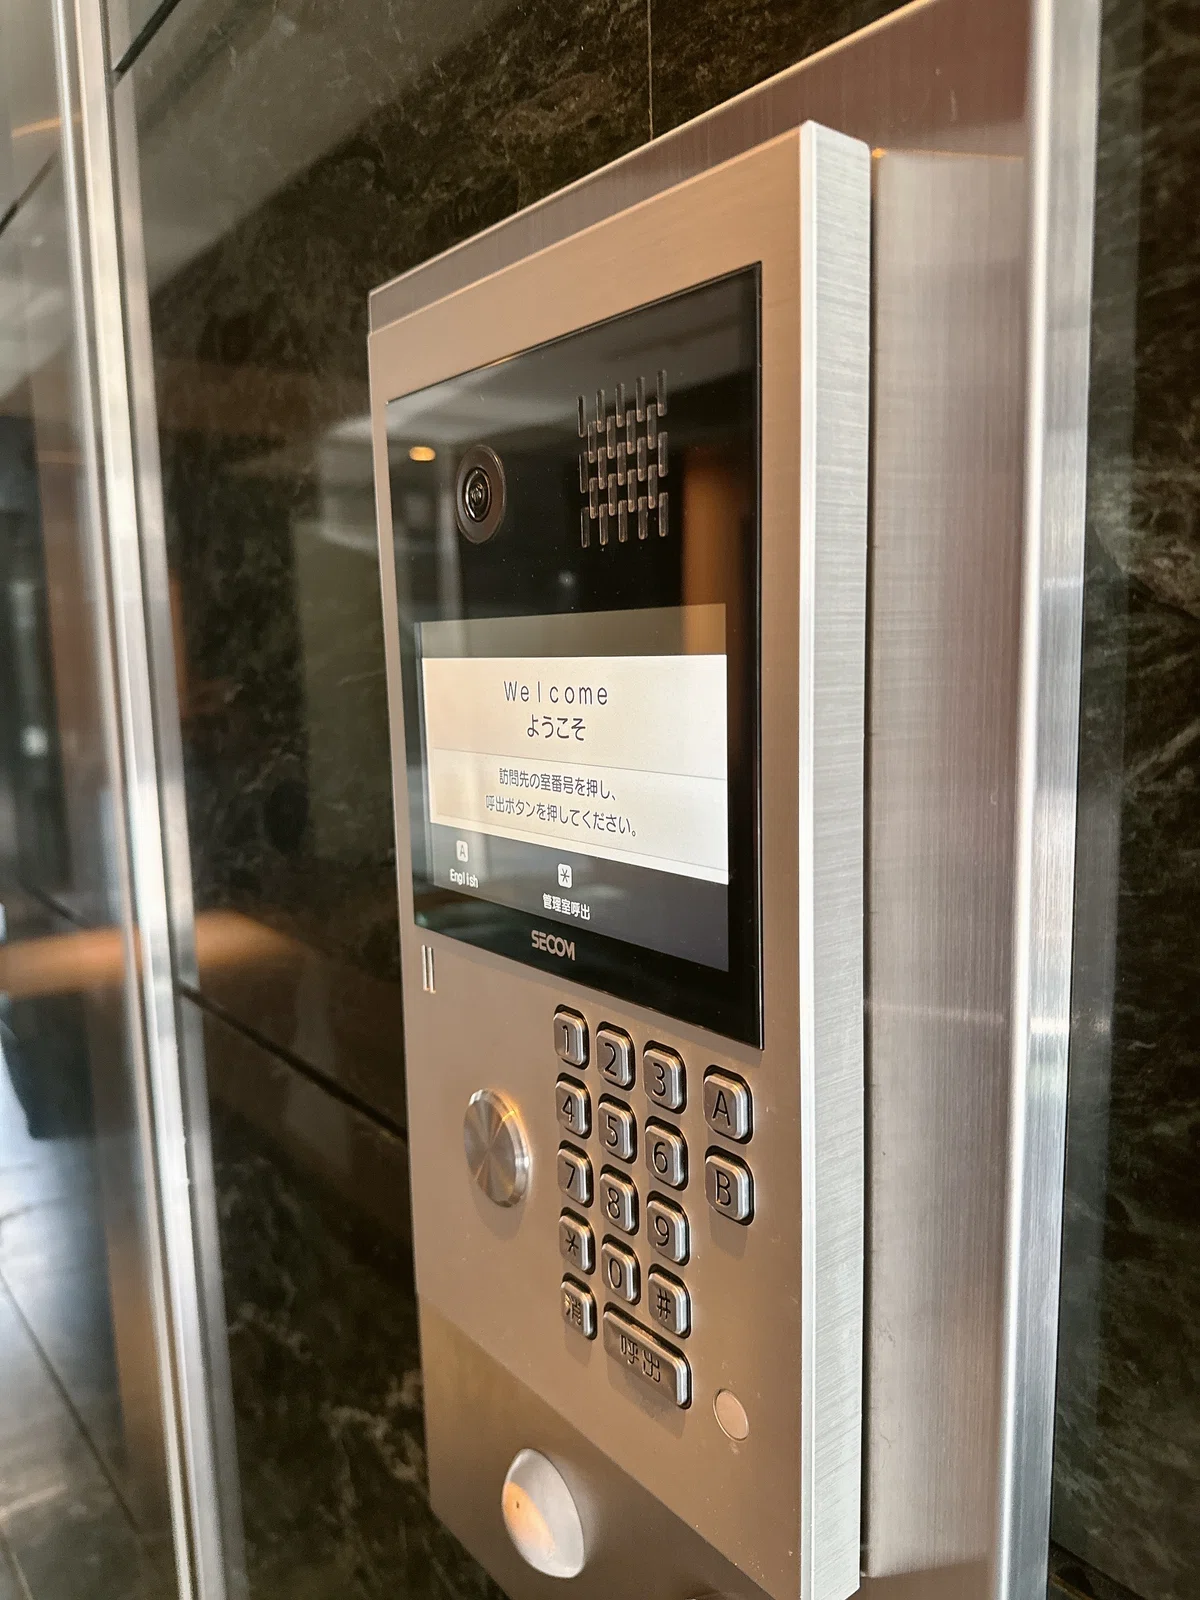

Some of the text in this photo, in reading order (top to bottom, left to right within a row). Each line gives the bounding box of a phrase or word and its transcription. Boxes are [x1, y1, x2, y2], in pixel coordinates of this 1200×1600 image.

[503, 681, 609, 706] Welcome
[526, 714, 587, 741] ようこそ
[499, 767, 617, 801] 訪問先の室番号を押し、
[485, 795, 637, 837] 呼出ボタンを押してください。
[449, 868, 479, 889] English
[542, 893, 591, 921] 管理室呼出
[531, 929, 576, 961] SECOM
[562, 1025, 570, 1055] 1
[604, 1042, 618, 1077] 2
[652, 1062, 667, 1097] 3
[562, 1095, 575, 1123] 4
[711, 1089, 732, 1129] A
[605, 1114, 619, 1148] 5
[653, 1141, 668, 1174] 6
[563, 1161, 577, 1191] 7
[715, 1170, 731, 1206] B
[605, 1186, 622, 1220] 8
[654, 1215, 670, 1247] 9
[607, 1257, 622, 1289] 0
[619, 1333, 662, 1384] 呼出
